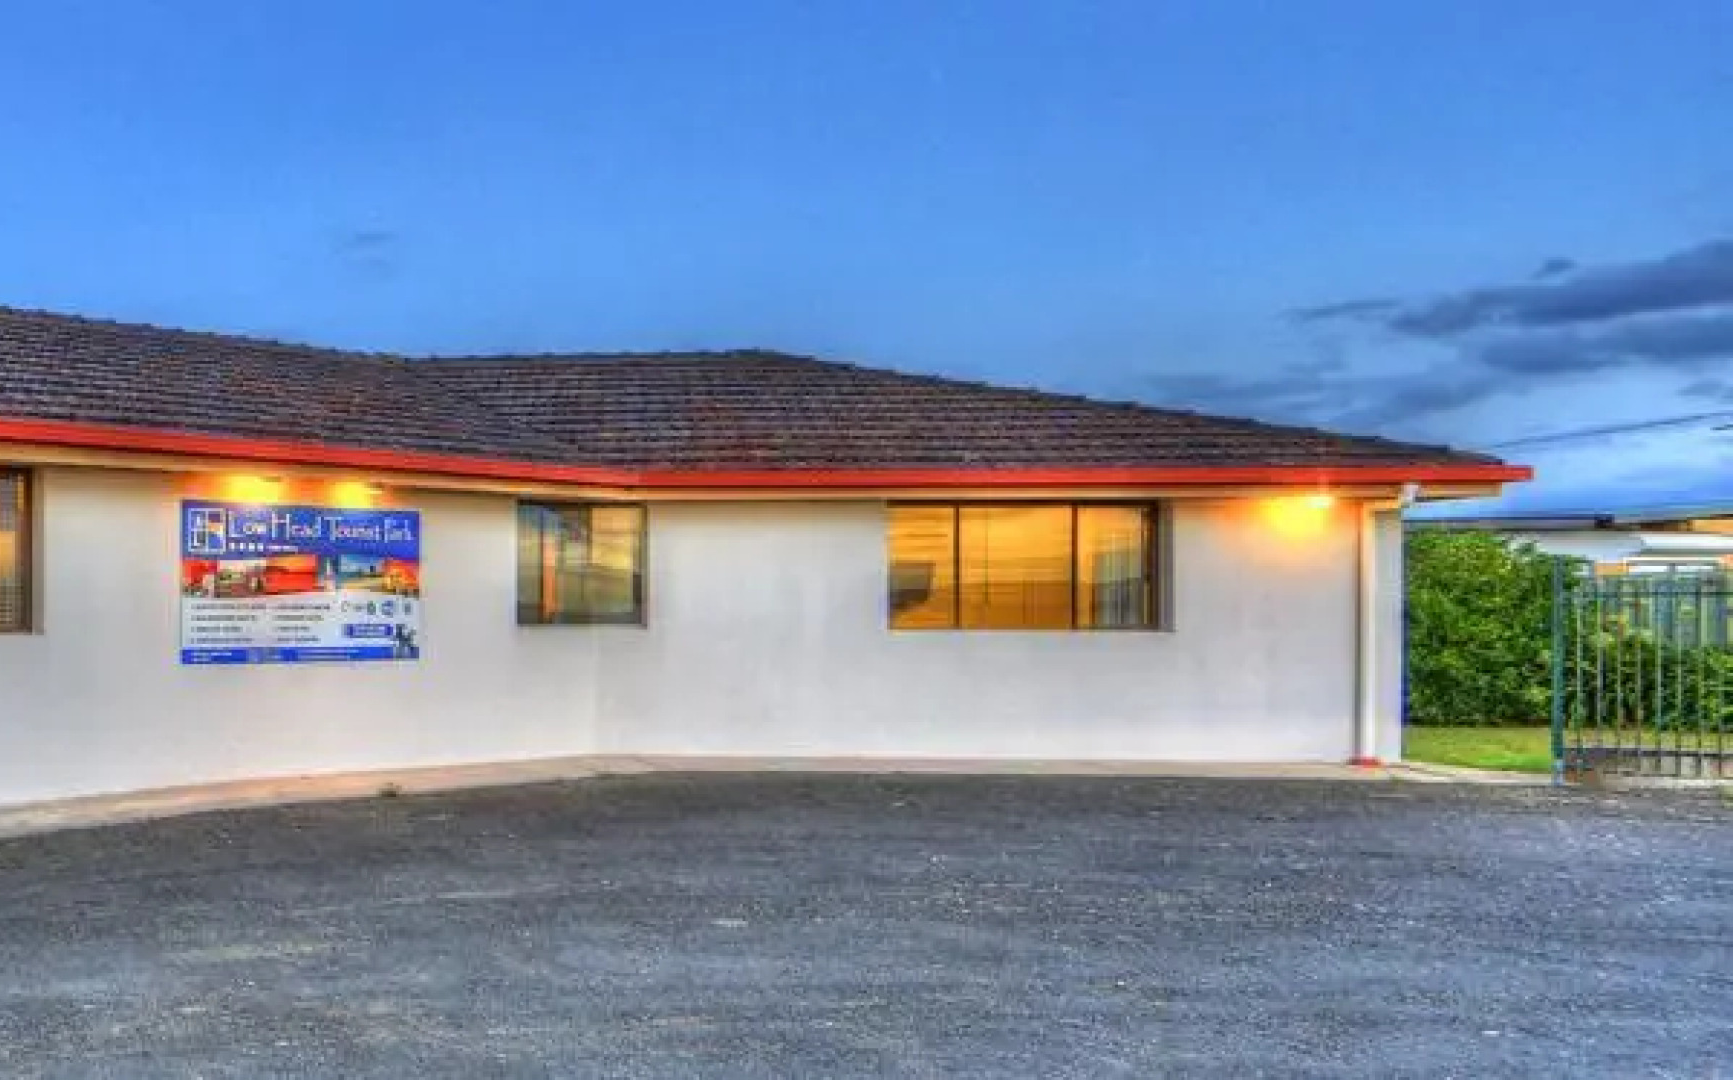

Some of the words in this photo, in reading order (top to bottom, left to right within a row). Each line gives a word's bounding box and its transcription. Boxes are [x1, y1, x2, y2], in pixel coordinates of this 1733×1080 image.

[228, 510, 267, 538] Low
[271, 512, 322, 541] Head
[324, 515, 380, 542] Tourist
[383, 518, 415, 544] Park
